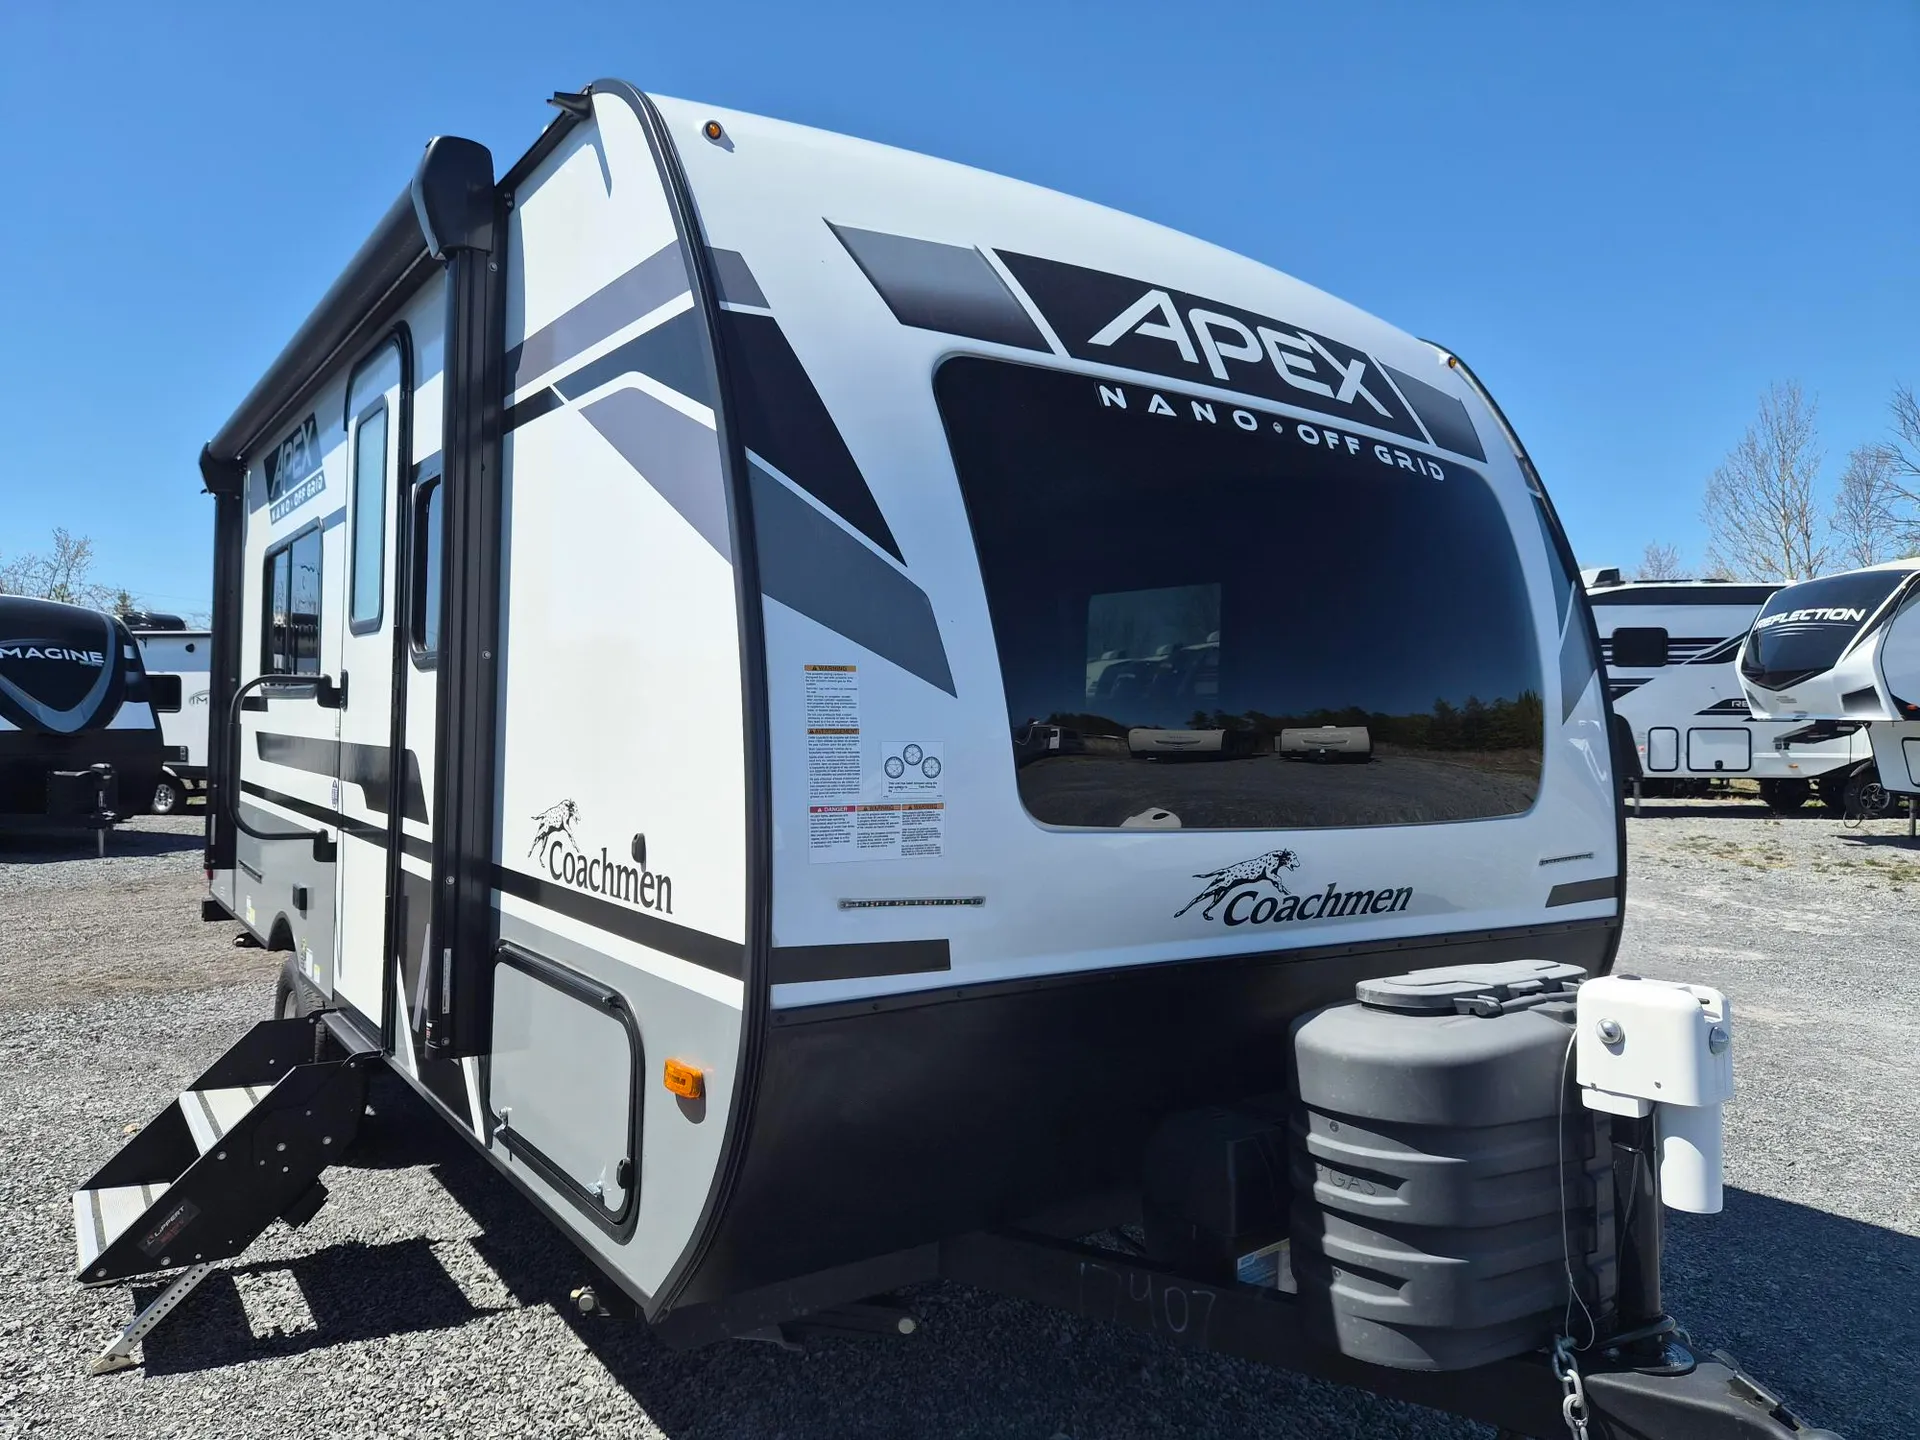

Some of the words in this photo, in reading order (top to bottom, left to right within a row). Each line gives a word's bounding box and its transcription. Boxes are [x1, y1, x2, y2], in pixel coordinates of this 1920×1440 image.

[1087, 288, 1394, 419] APEX
[270, 420, 315, 498] APEX
[1099, 384, 1259, 432] NANO
[1296, 423, 1361, 456] OFF
[1373, 444, 1446, 482] GRID
[271, 499, 291, 522] NANO
[292, 488, 307, 506] OFF
[306, 474, 323, 497] GRID
[1755, 608, 1866, 630] REFLECTION
[549, 839, 673, 915] Coachmen
[1223, 882, 1414, 927] Coachmen
